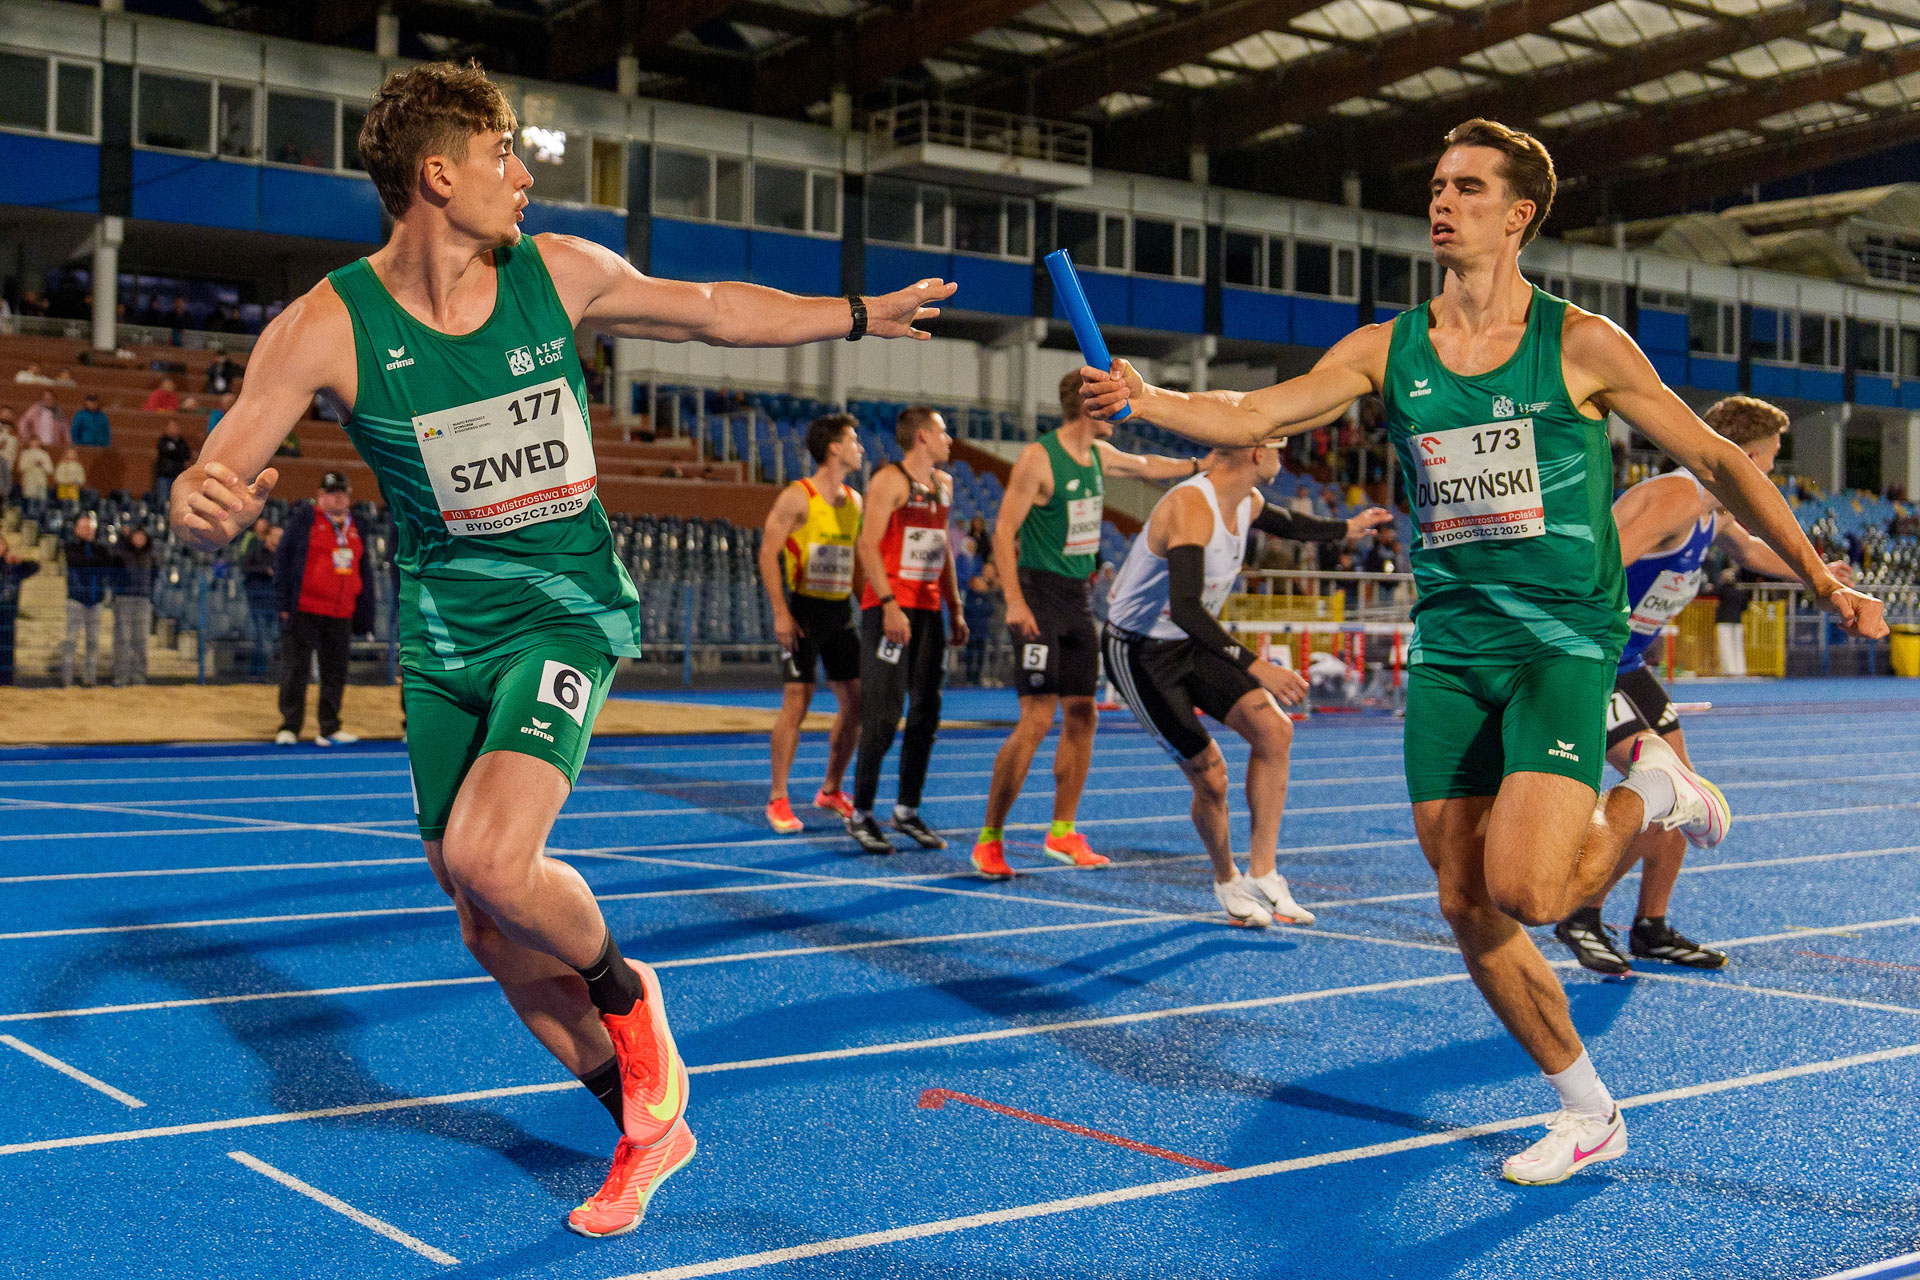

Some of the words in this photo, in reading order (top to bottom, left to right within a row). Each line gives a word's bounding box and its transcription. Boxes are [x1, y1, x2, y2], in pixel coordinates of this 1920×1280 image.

[386, 357, 414, 371] erima
[1409, 387, 1432, 398] erima
[507, 387, 561, 426] 177
[1471, 427, 1521, 455] 173
[450, 439, 569, 493] SZWED
[451, 511, 469, 520] 101.
[470, 508, 495, 519] PZLA
[496, 490, 559, 514] Mistrzostwa
[561, 480, 592, 497] Polski
[1418, 468, 1534, 508] DUSZYŃSKI
[466, 507, 549, 532] BYDGOSZCZ
[551, 498, 584, 515] 2025
[1434, 520, 1457, 531] PZLA
[1457, 514, 1507, 527] Mistrzostwa
[1508, 509, 1537, 521] Polski
[1431, 527, 1499, 545] BYDGOSZCZ
[1500, 523, 1529, 535] 2025
[1029, 647, 1041, 666] 5
[553, 669, 583, 710] 6
[520, 726, 555, 743] erima
[1547, 748, 1579, 762] erima
